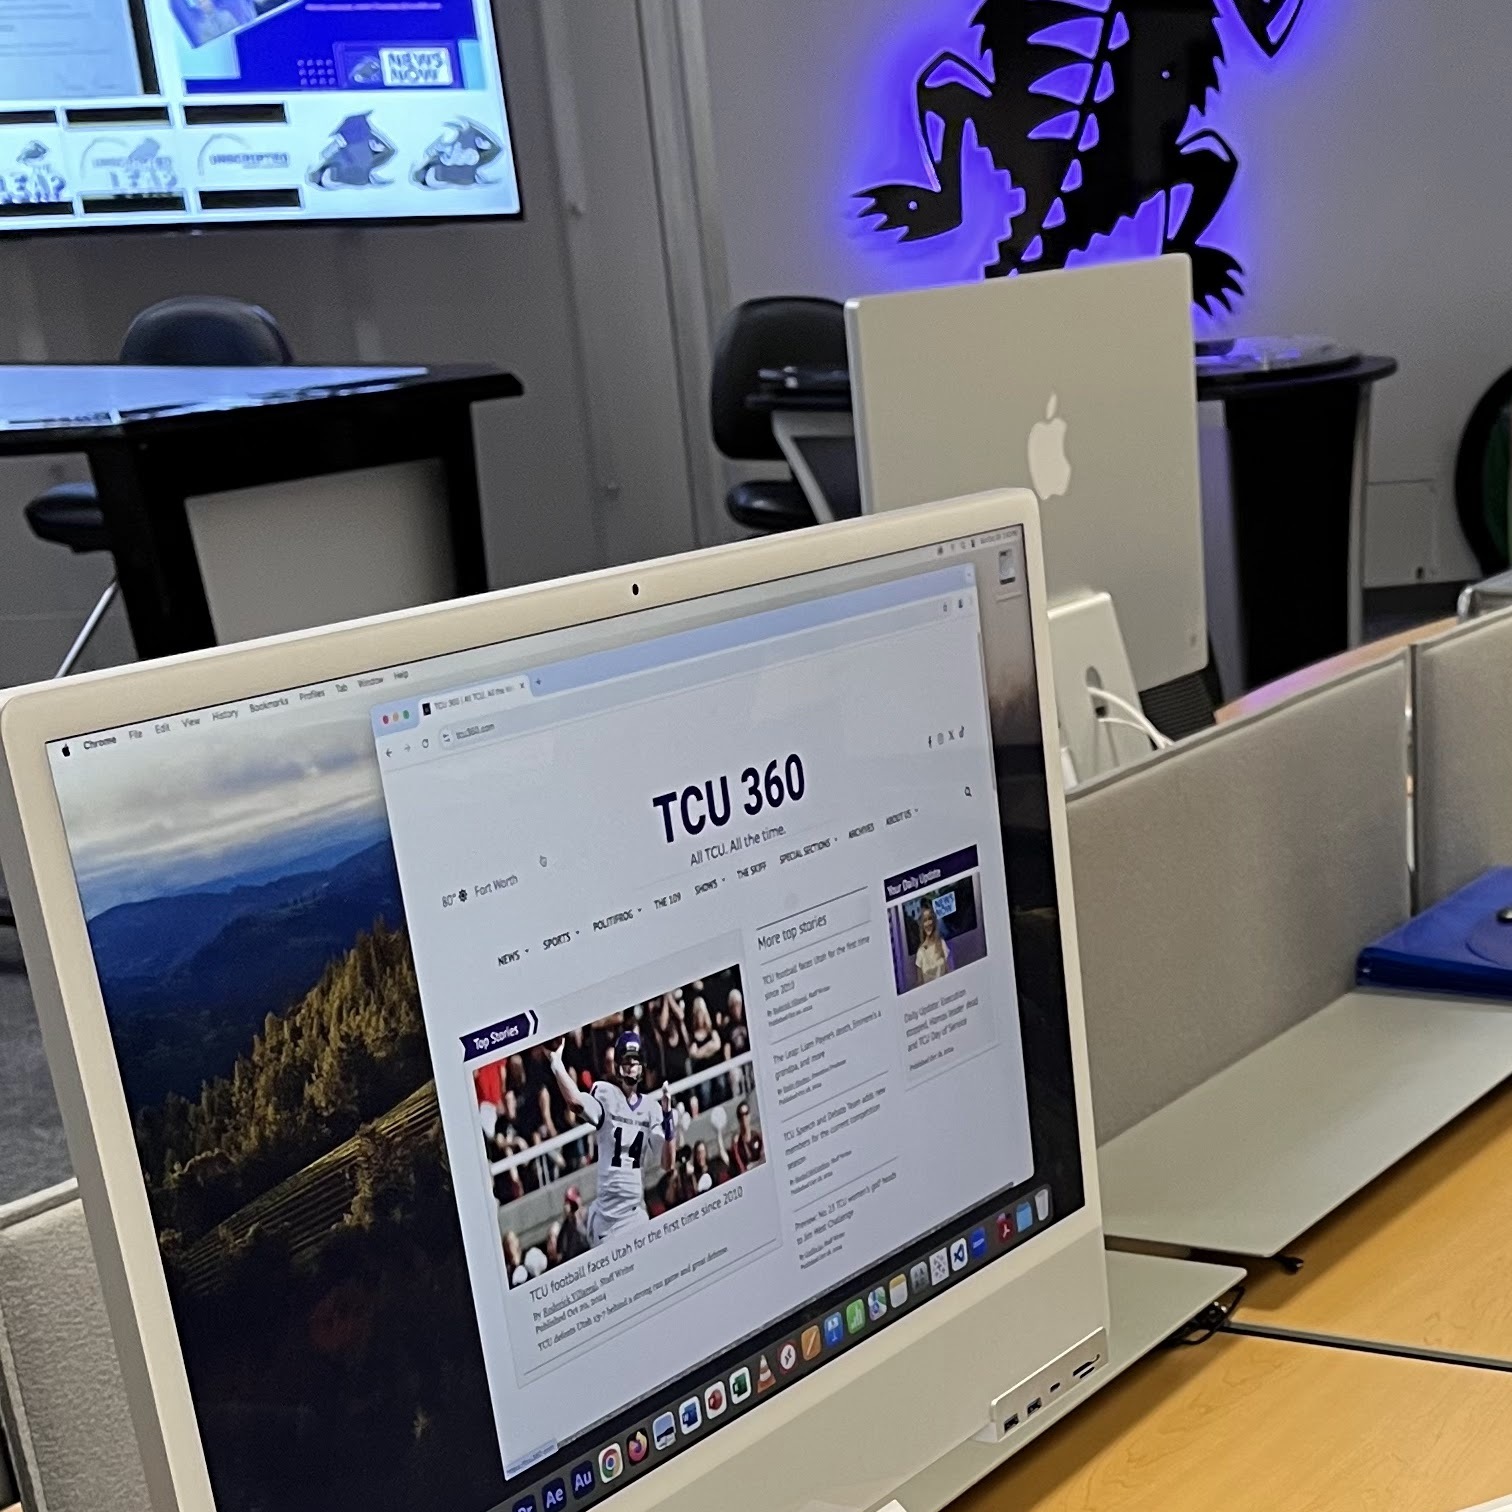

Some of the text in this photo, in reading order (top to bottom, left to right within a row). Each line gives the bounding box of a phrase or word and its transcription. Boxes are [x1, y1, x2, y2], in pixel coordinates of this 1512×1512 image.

[83, 736, 117, 750] Chrome
[652, 753, 805, 842] TCU 360
[690, 825, 786, 866] All TCU. All the time.
[473, 882, 493, 897] Fort
[492, 874, 518, 890] Worth
[757, 914, 827, 950] More top stories
[472, 1025, 519, 1050] Top Stories
[611, 1126, 644, 1169] 14
[528, 1185, 743, 1302] TCU football faces Utah for the first time since 2010
[574, 1470, 592, 1491] Au
[545, 1487, 564, 1508] Ae
